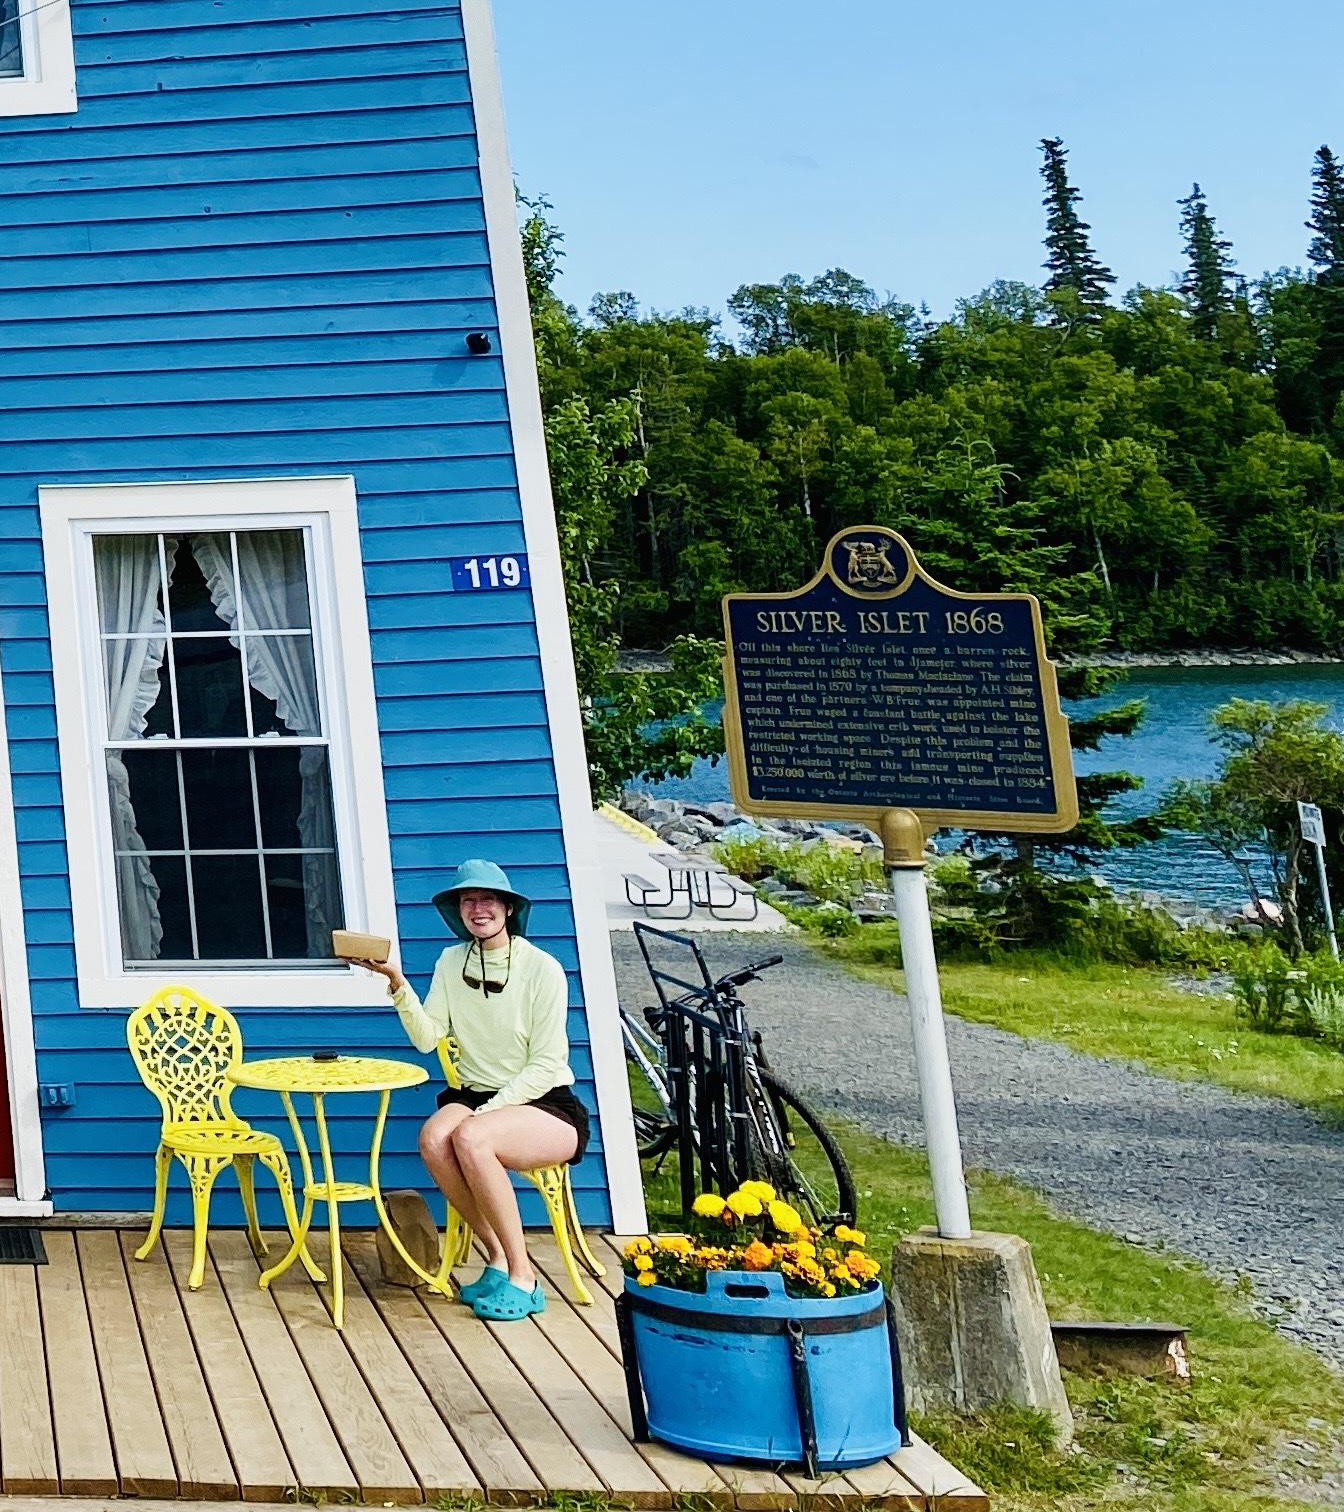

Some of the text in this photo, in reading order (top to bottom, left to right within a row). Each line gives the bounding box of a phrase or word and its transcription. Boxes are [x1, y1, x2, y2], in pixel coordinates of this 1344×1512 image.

[464, 557, 521, 588] 119
[756, 606, 1005, 635] SILVER ISLET 1868
[762, 641, 781, 652] this
[787, 642, 816, 653] shore
[846, 643, 875, 654] Silver
[980, 671, 1001, 682] The
